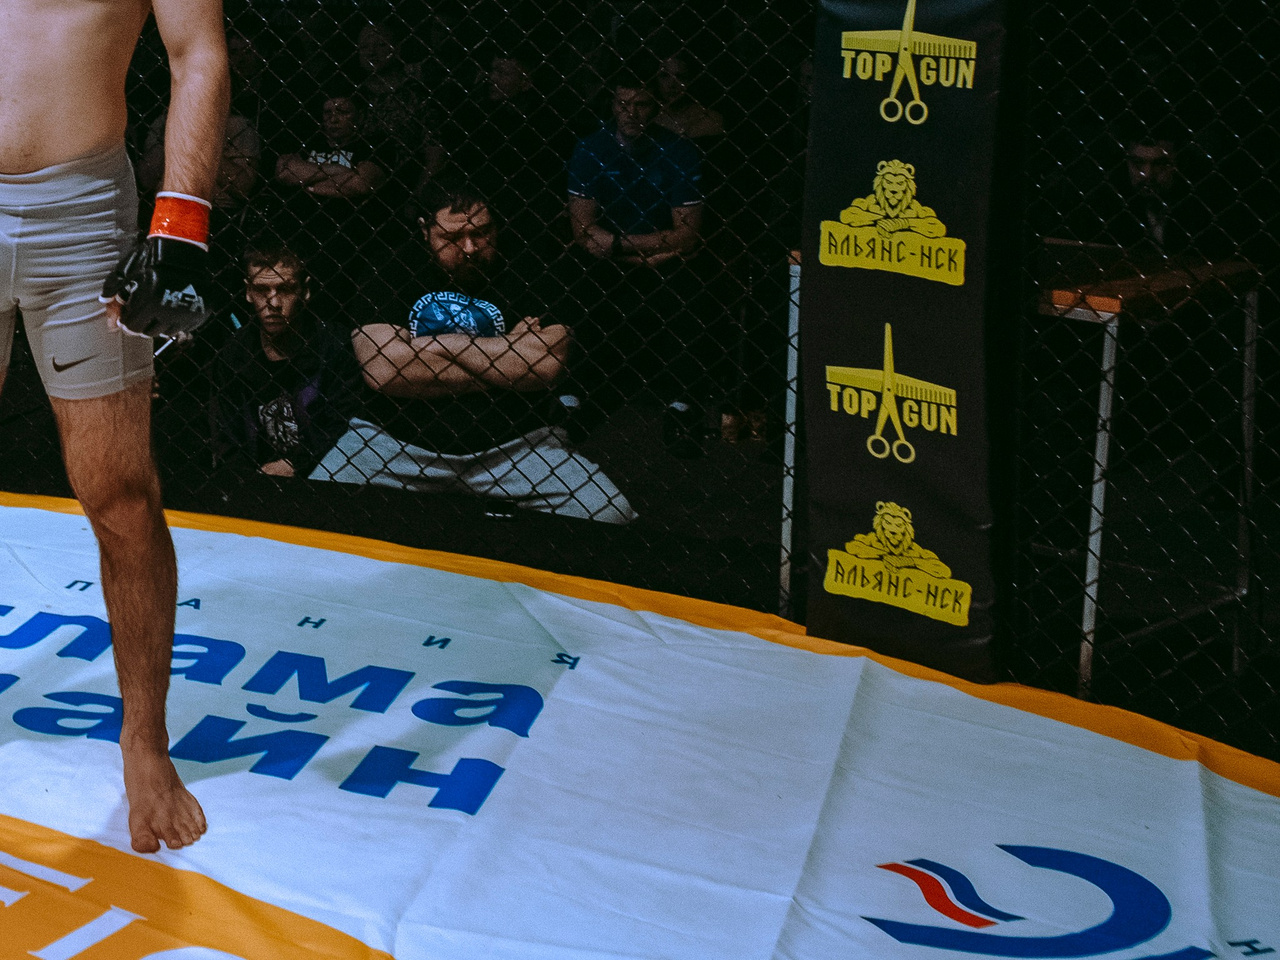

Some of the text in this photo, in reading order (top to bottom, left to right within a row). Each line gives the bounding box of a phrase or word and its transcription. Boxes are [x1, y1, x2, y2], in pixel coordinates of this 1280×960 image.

[841, 50, 976, 89] TOP GUN
[827, 230, 958, 272] АЛЬЯНС-НСК
[826, 382, 958, 436] TOP GUN
